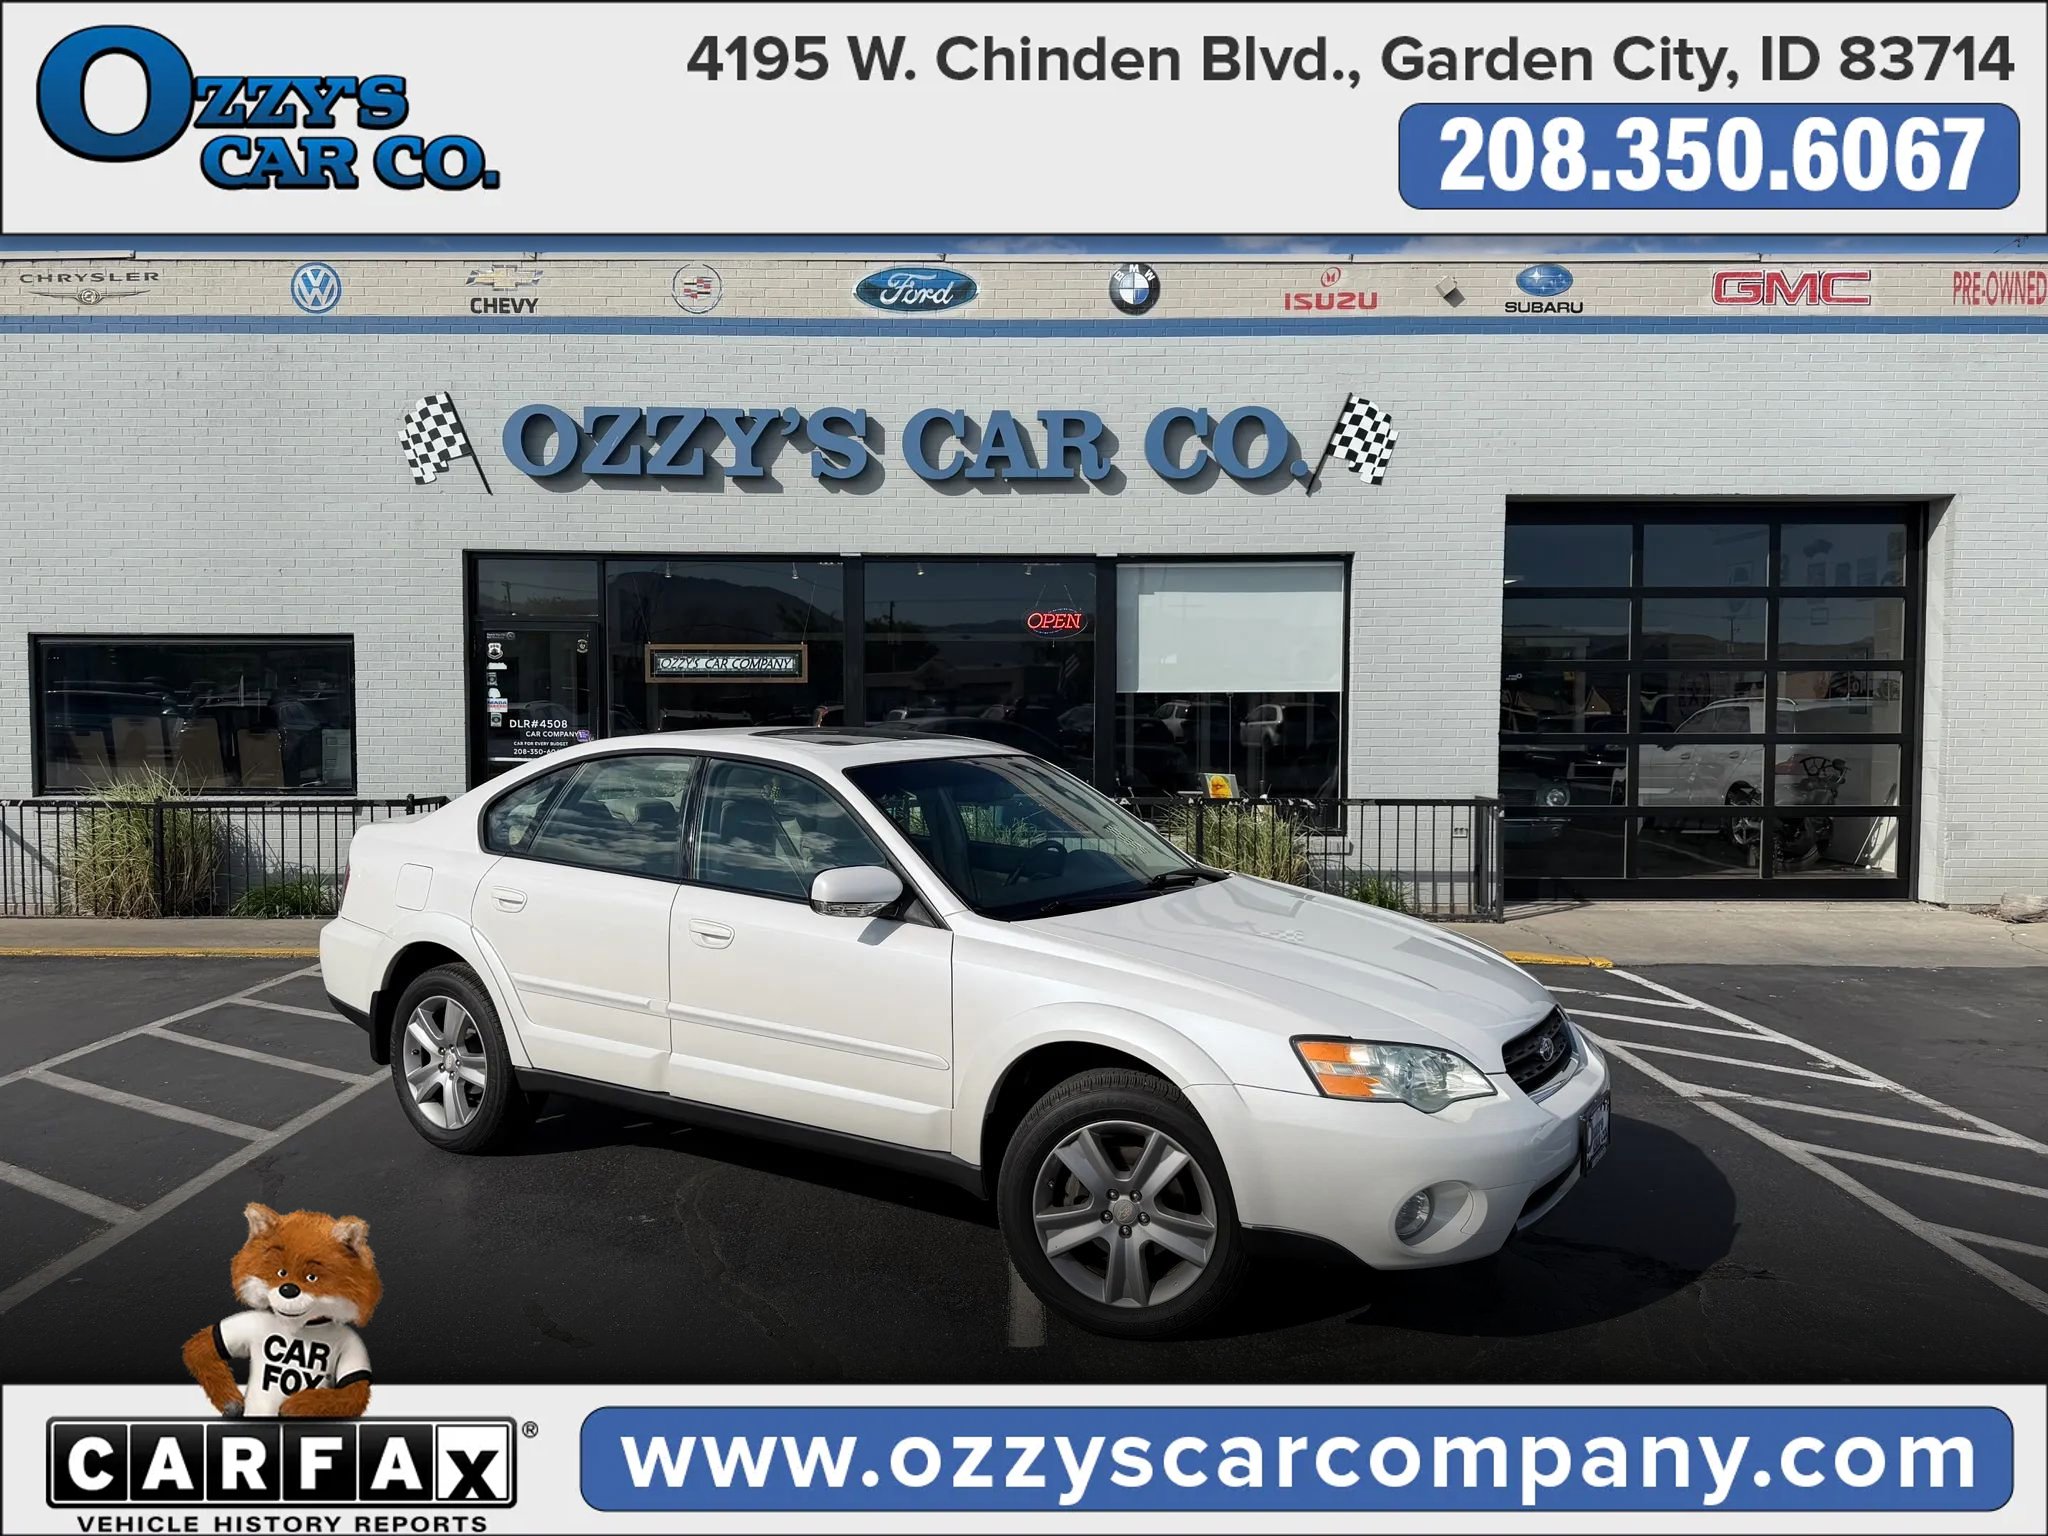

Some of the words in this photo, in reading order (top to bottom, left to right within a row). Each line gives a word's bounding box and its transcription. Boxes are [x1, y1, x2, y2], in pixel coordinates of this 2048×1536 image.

[19, 271, 159, 284] CHRYSLER
[1114, 264, 1156, 281] BMW
[880, 272, 954, 305] Ford
[1712, 271, 1872, 306] GMC
[1953, 271, 2048, 305] PRE-OWNED
[470, 297, 539, 315] CHEVY
[1284, 292, 1378, 310] ISUZU
[1504, 302, 1584, 314] SUBARU
[502, 405, 869, 480] OZZY'S
[902, 406, 1112, 480] CAR
[1145, 405, 1310, 480] CO.
[1027, 612, 1082, 629] OPEN
[660, 658, 699, 669] OZZY'S
[704, 658, 728, 669] CAR
[731, 658, 792, 669] COMPANY
[509, 719, 569, 729] DLR#4508
